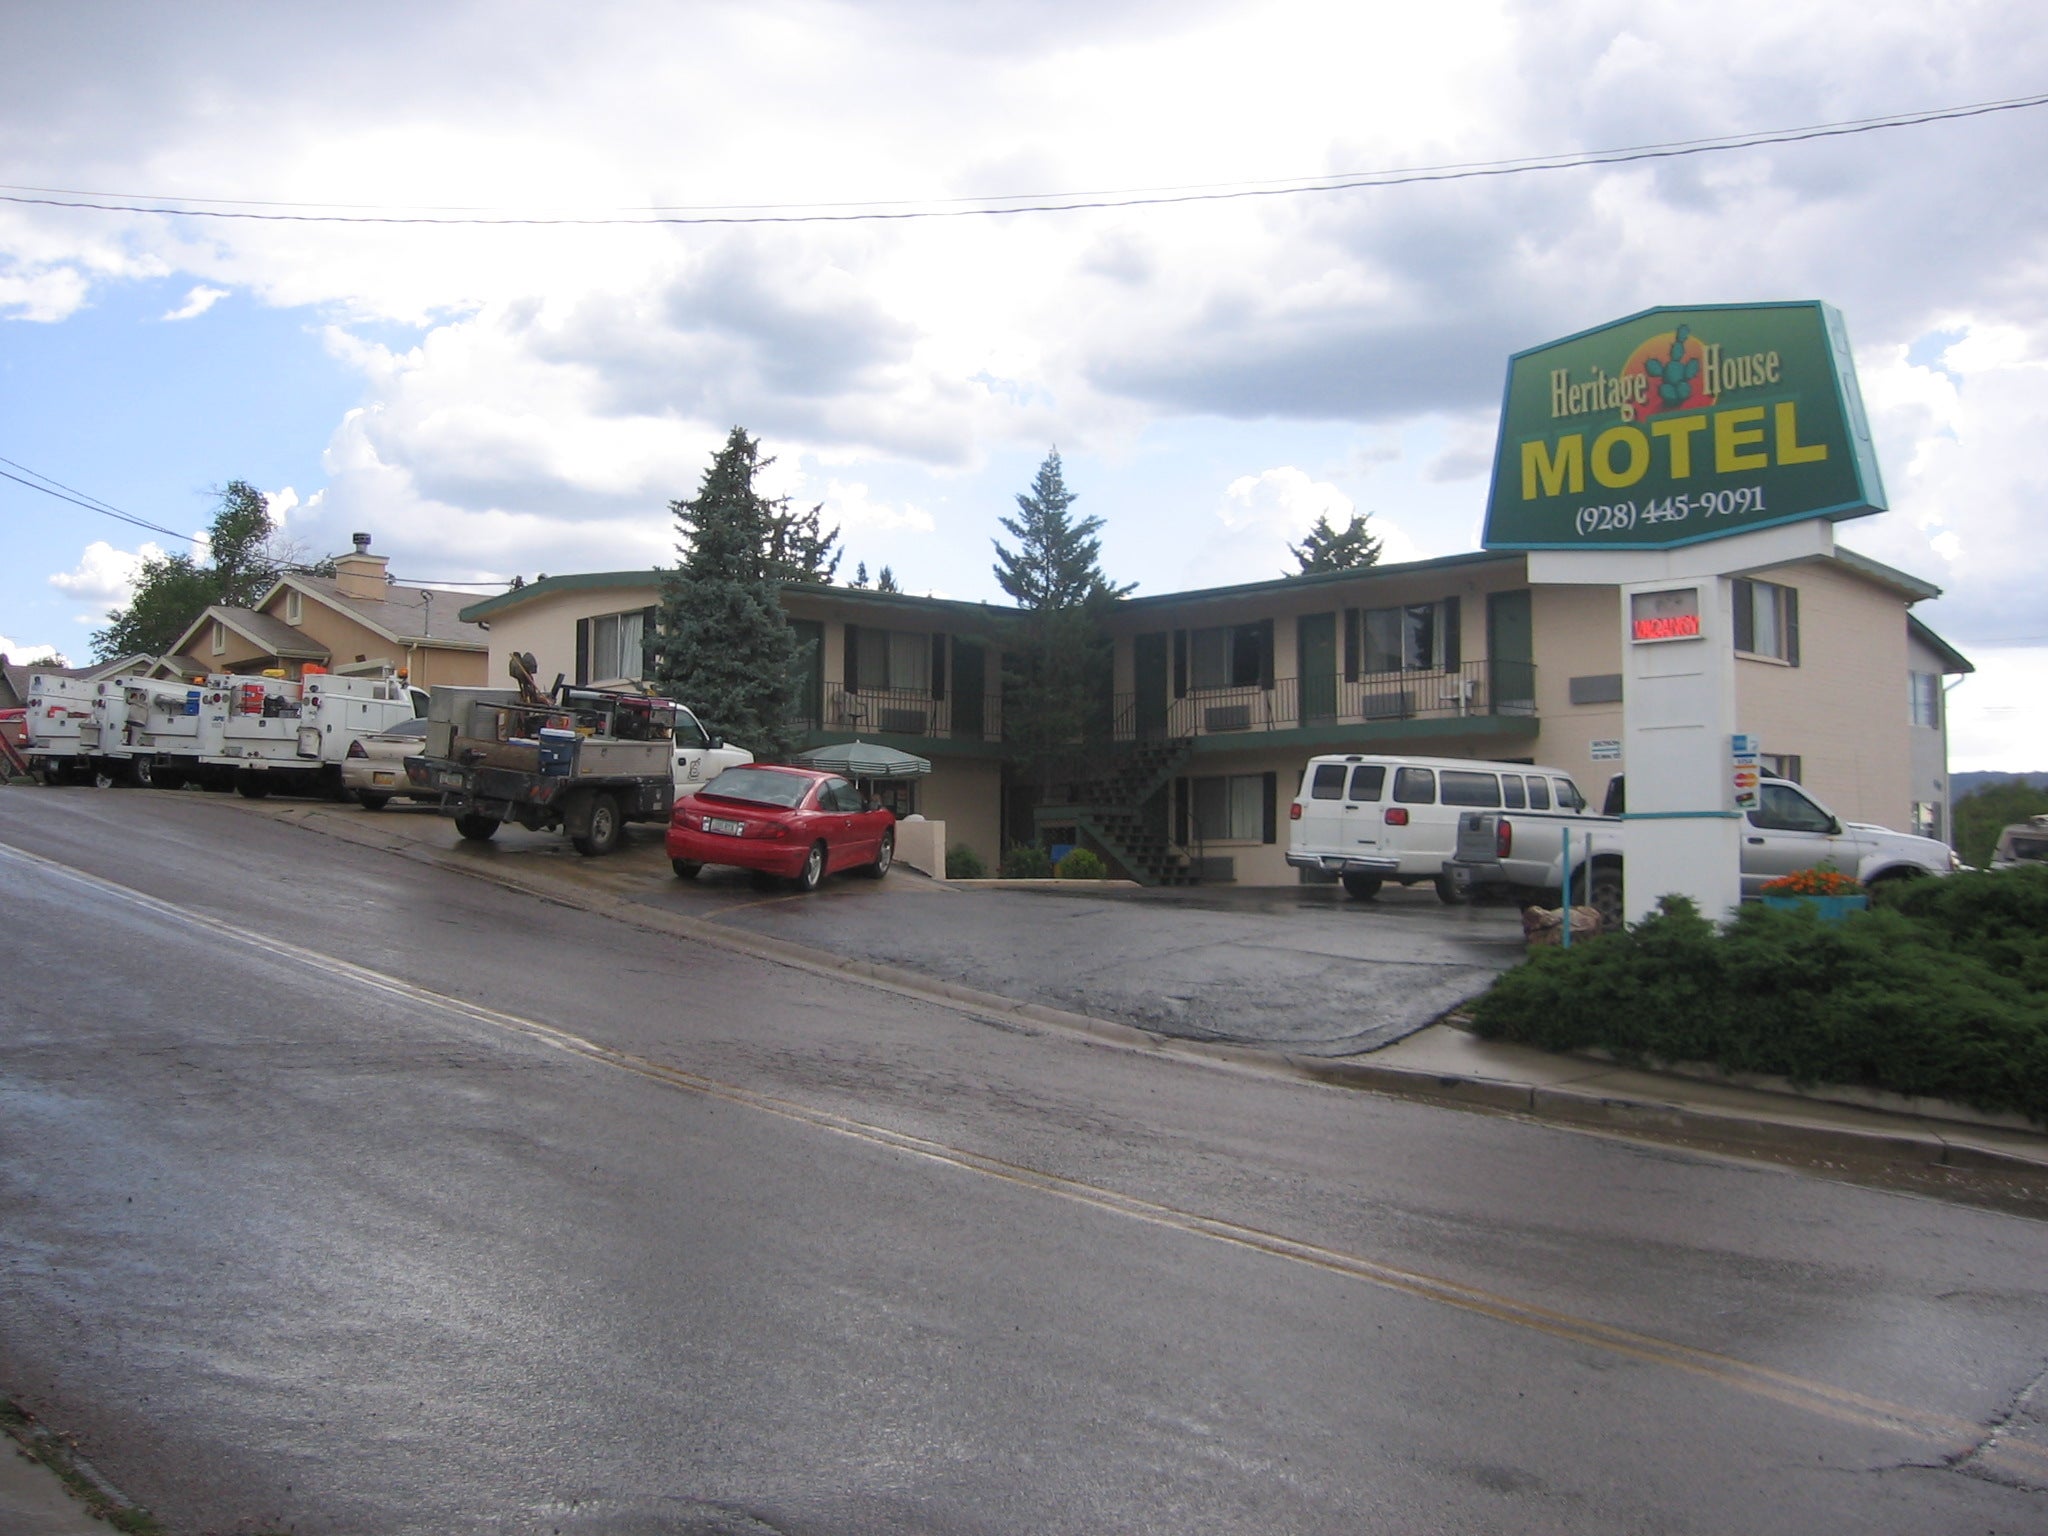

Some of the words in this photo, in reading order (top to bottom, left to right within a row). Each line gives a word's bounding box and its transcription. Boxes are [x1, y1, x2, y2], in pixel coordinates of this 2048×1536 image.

[1550, 366, 1648, 422] Heritage
[1701, 343, 1780, 396] House
[1521, 401, 1828, 501] MOTEL
[1575, 501, 1636, 536] (928)
[1640, 486, 1766, 523] 445-9091
[1635, 615, 1699, 639] VACANCY
